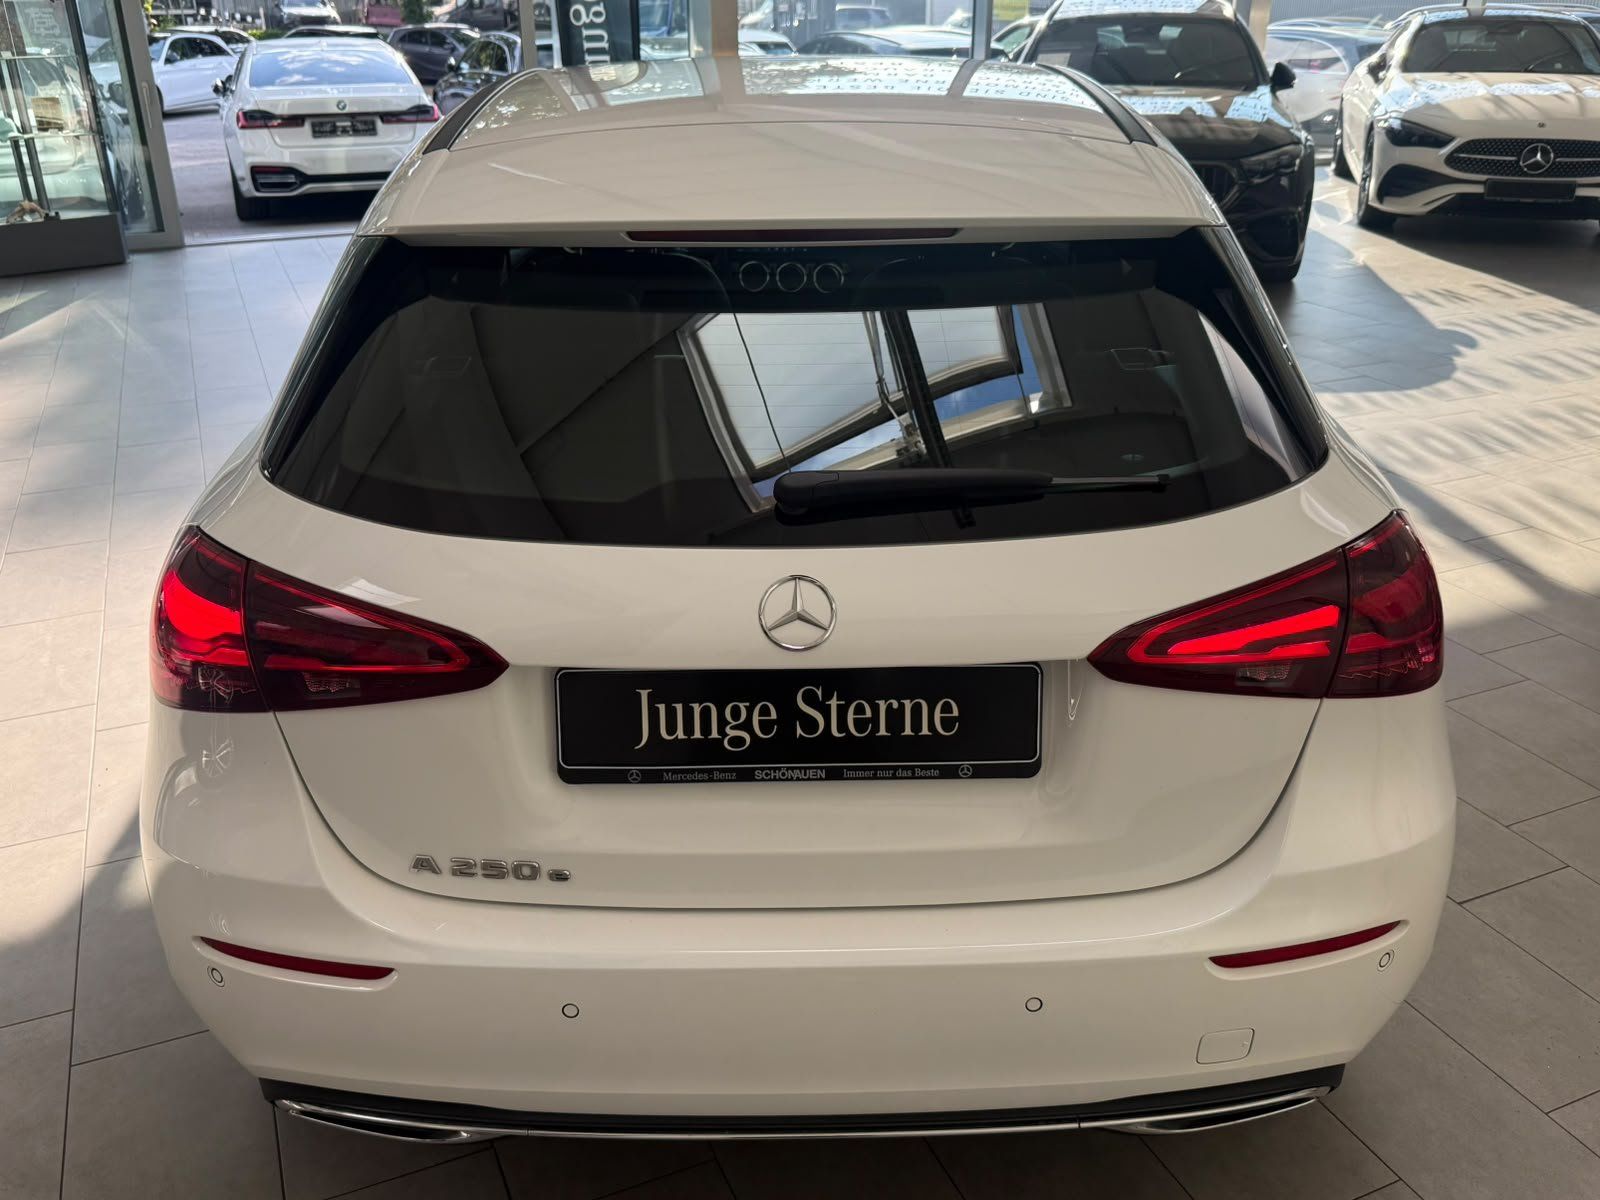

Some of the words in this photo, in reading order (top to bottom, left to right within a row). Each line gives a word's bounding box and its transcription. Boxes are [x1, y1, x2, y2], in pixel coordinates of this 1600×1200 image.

[634, 689, 777, 751] Junge
[796, 685, 960, 739] Sterne
[662, 771, 737, 782] Mercedes-Benz
[754, 767, 826, 780] SCHÖNAUEN
[842, 768, 873, 779] Immer
[876, 769, 894, 778] nur
[896, 767, 913, 778] das
[914, 767, 940, 777] Beste
[410, 855, 442, 875] A
[450, 857, 541, 881] 250
[547, 868, 572, 882] e
